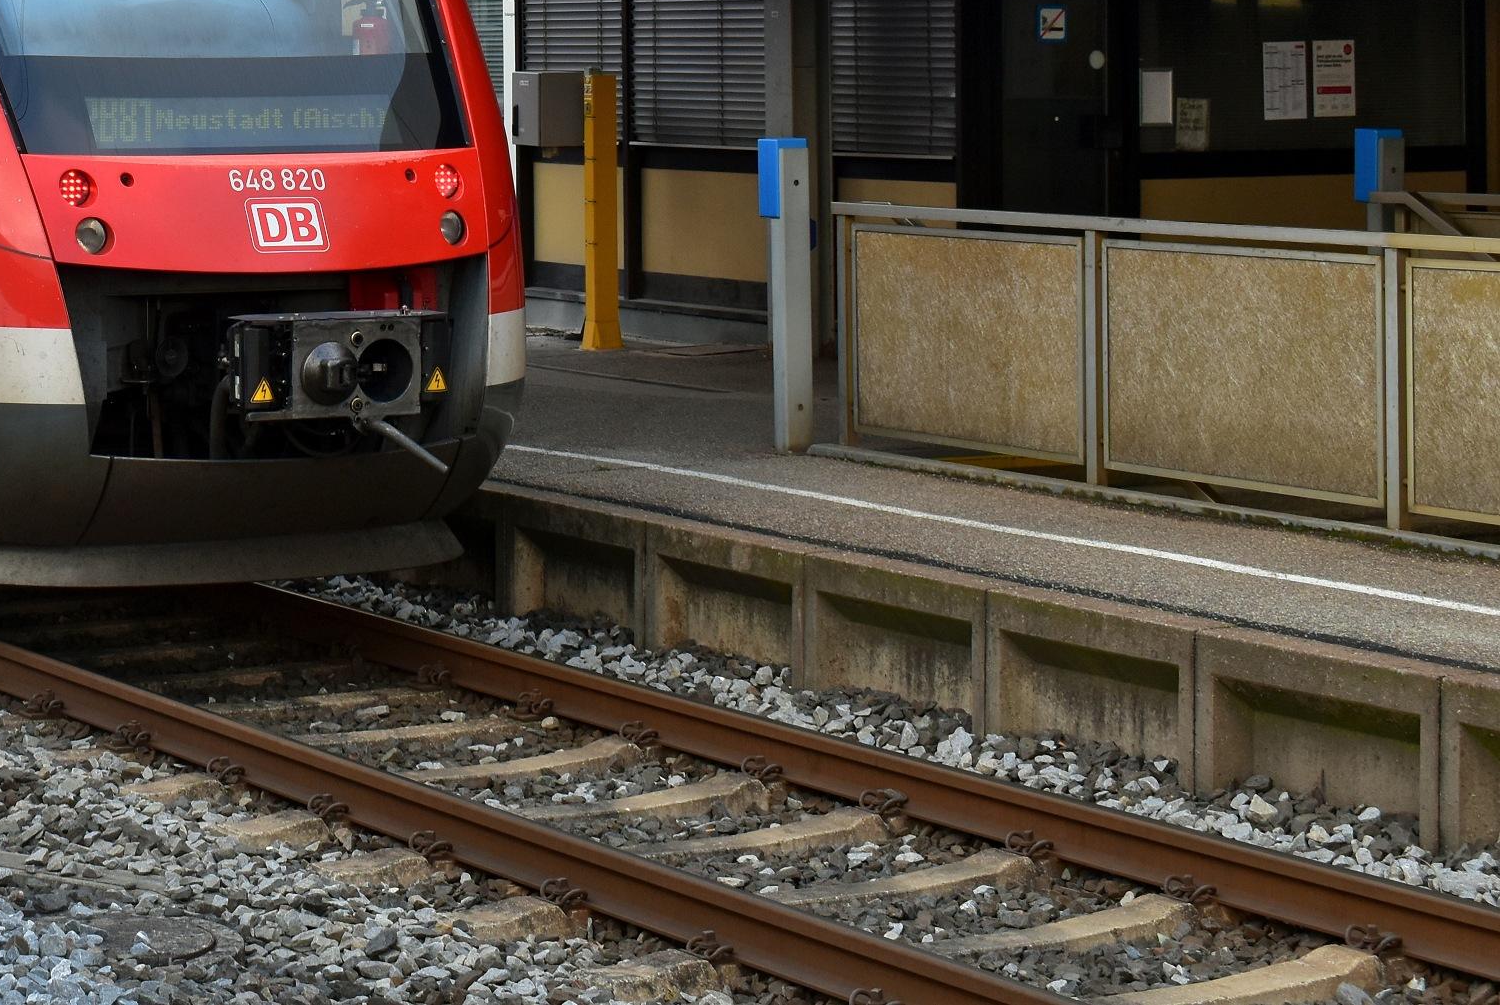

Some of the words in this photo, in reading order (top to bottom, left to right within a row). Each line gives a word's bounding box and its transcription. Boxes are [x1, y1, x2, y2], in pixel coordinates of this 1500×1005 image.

[155, 107, 285, 131] Neustadt
[228, 168, 275, 192] 648
[280, 168, 326, 191] 820
[256, 206, 318, 243] DB
